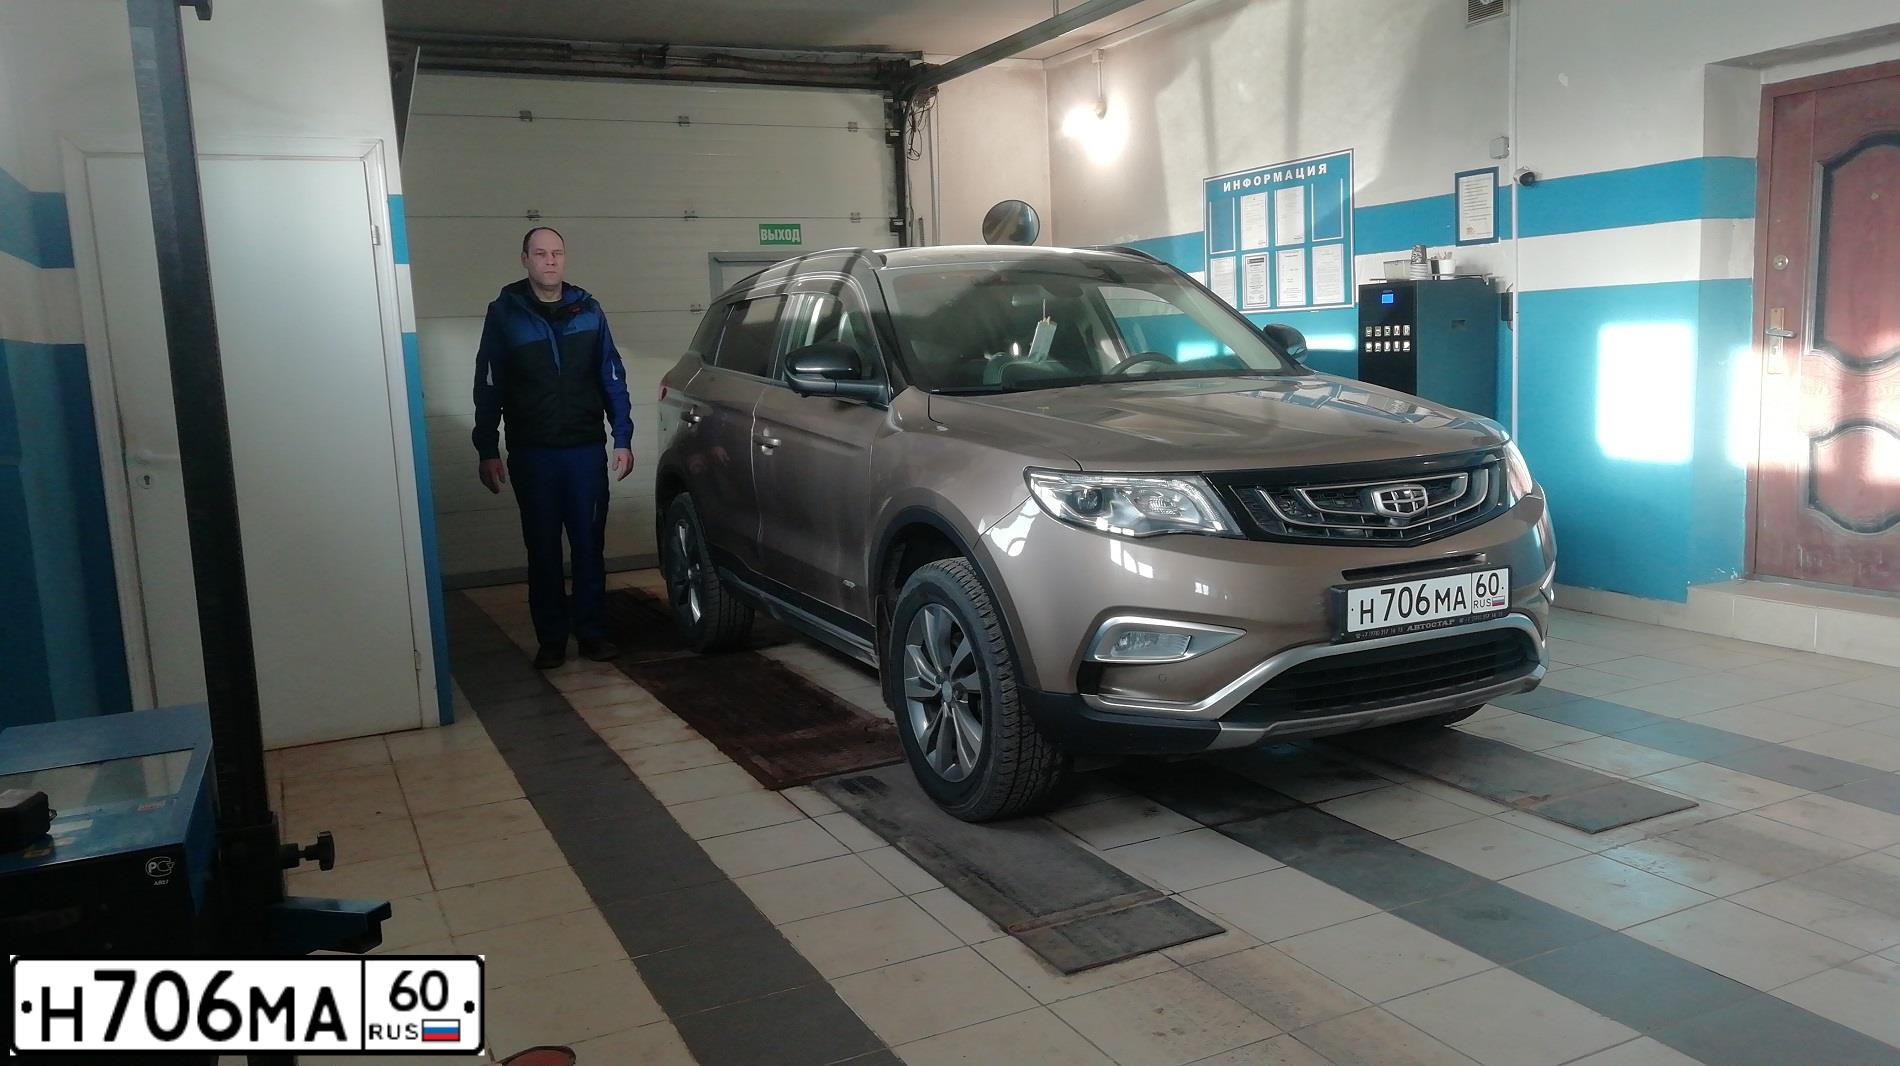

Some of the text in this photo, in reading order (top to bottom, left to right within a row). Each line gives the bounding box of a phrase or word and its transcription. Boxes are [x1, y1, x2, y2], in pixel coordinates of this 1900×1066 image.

[1222, 163, 1327, 192] ИНФОРМАЦИЯ
[760, 229, 801, 242] ВЫХОД
[1360, 572, 1500, 625] Н706МА 60
[1473, 600, 1492, 609] RUS
[1406, 619, 1456, 632] АВТОСТАР
